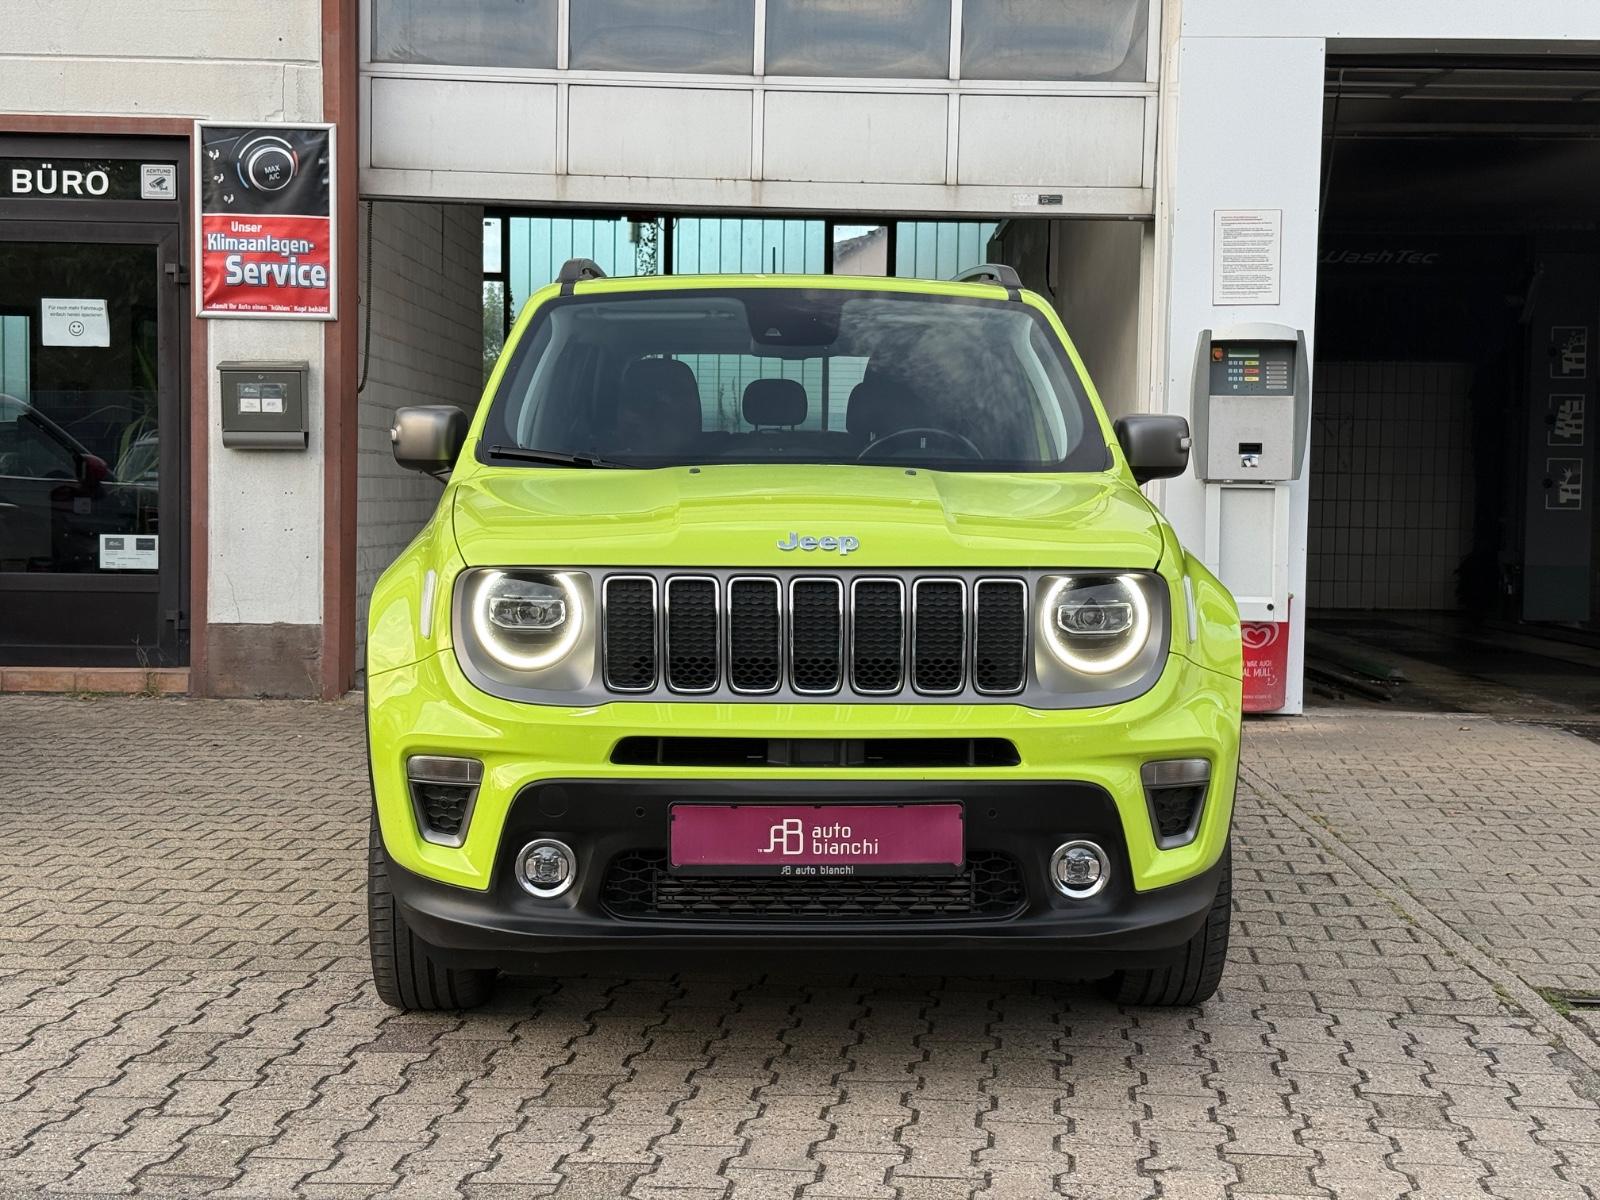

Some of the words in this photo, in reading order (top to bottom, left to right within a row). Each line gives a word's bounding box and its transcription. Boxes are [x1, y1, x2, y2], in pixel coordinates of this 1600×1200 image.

[264, 164, 281, 175] MAX
[268, 172, 281, 182] A/C
[12, 163, 110, 196] BÜRO
[231, 221, 262, 233] Unser
[207, 233, 315, 256] Klimaanlagen-
[225, 254, 326, 287] Service
[776, 531, 859, 556] Jeep
[812, 822, 851, 838] auto
[812, 838, 879, 855] bianchi
[795, 865, 816, 875] auto
[820, 865, 854, 875] bianchi
